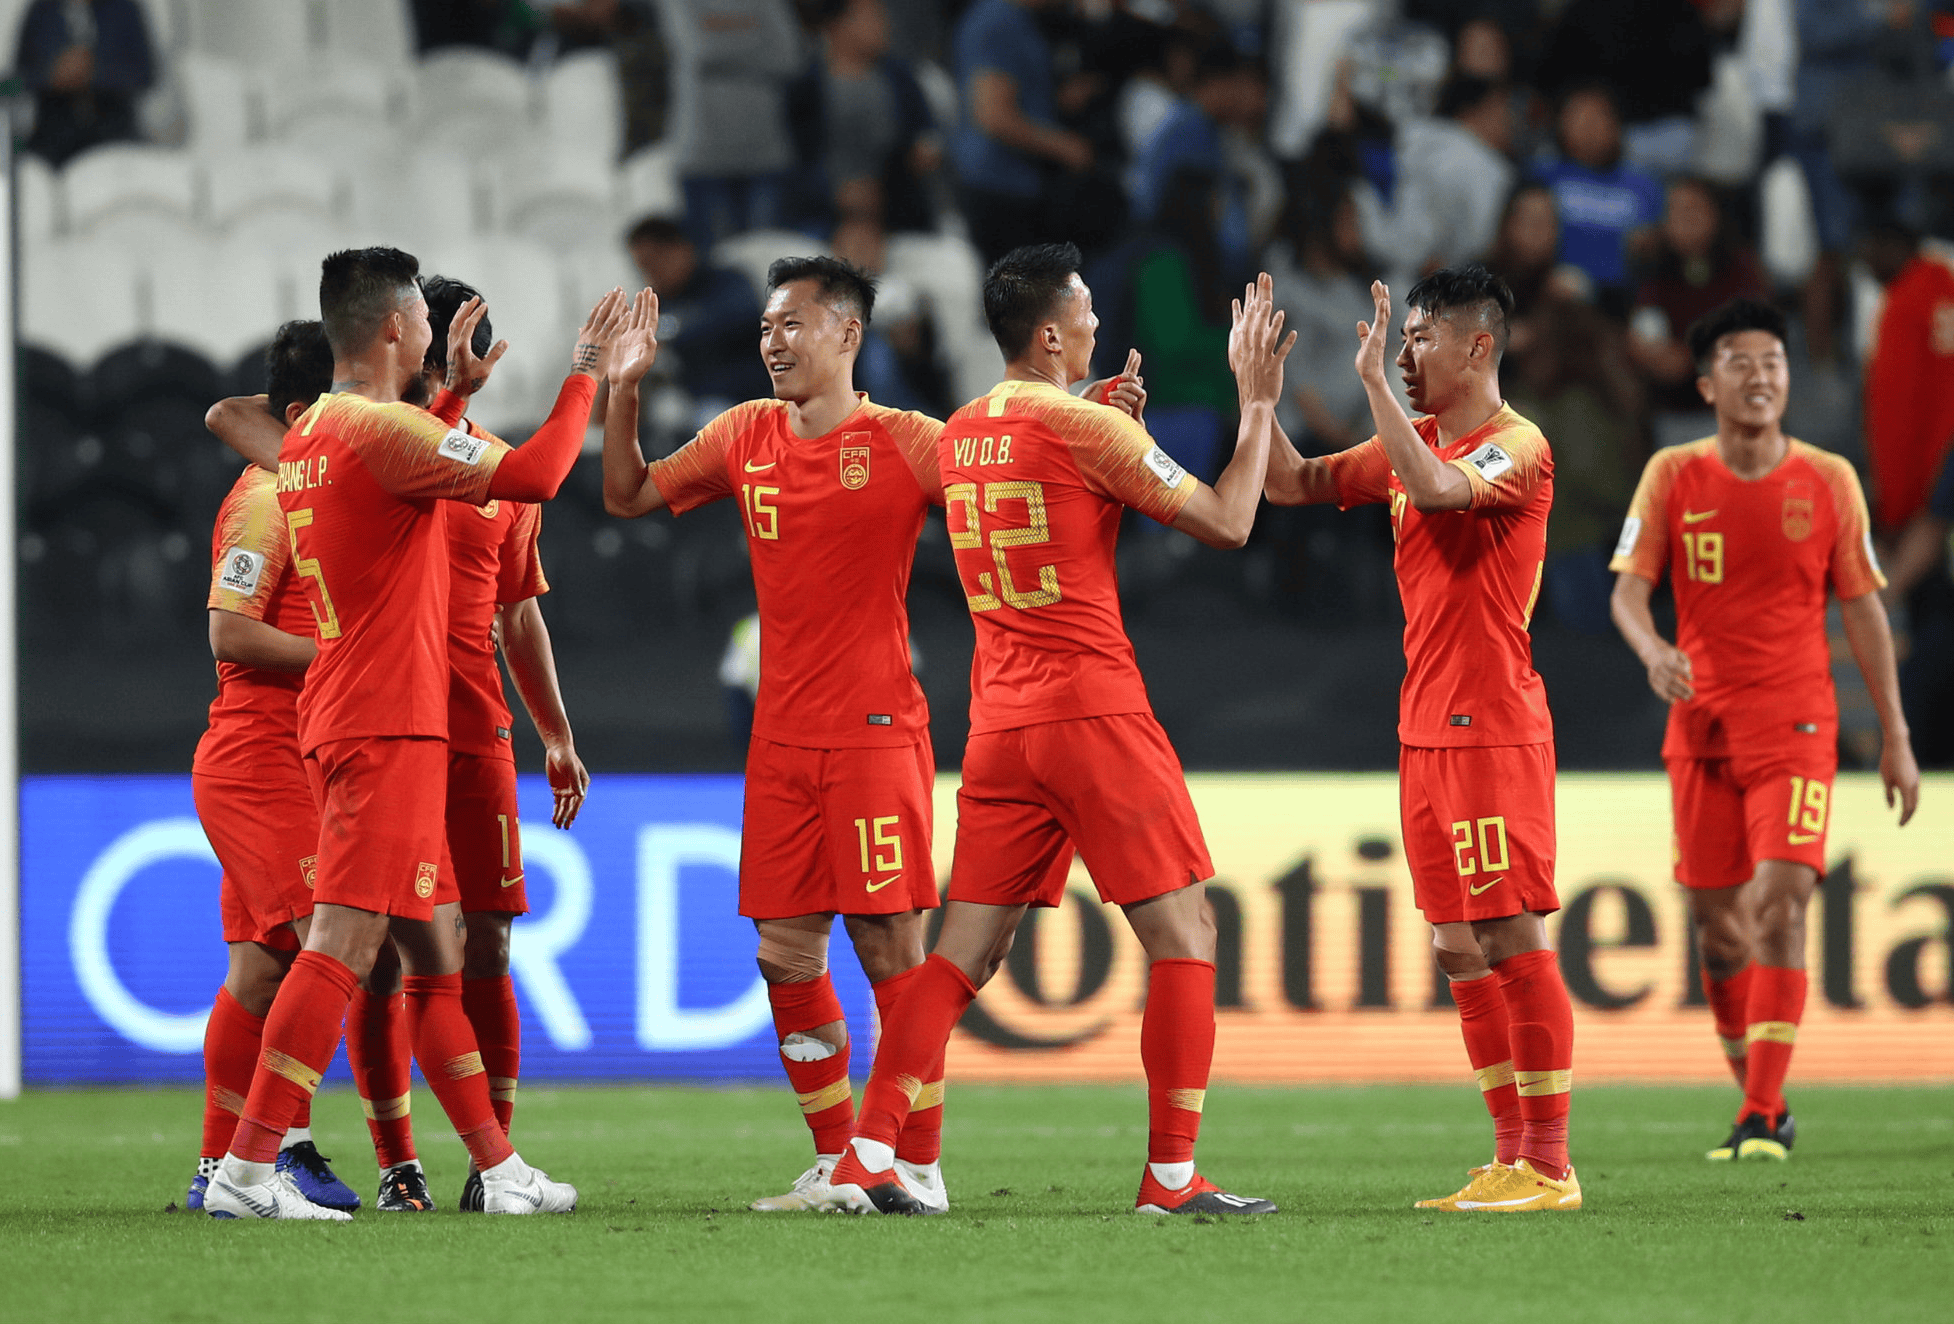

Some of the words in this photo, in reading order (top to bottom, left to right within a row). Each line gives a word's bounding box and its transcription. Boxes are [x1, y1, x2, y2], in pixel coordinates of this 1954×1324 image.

[306, 455, 332, 488] L.P.
[843, 450, 867, 459] CFA
[954, 437, 978, 467] YU
[742, 483, 780, 540] 15
[287, 507, 342, 639] 5
[946, 481, 1062, 613] 22
[1682, 532, 1724, 584] 19
[1787, 776, 1829, 833] 19
[854, 815, 903, 873] 15
[1452, 816, 1511, 876] 20
